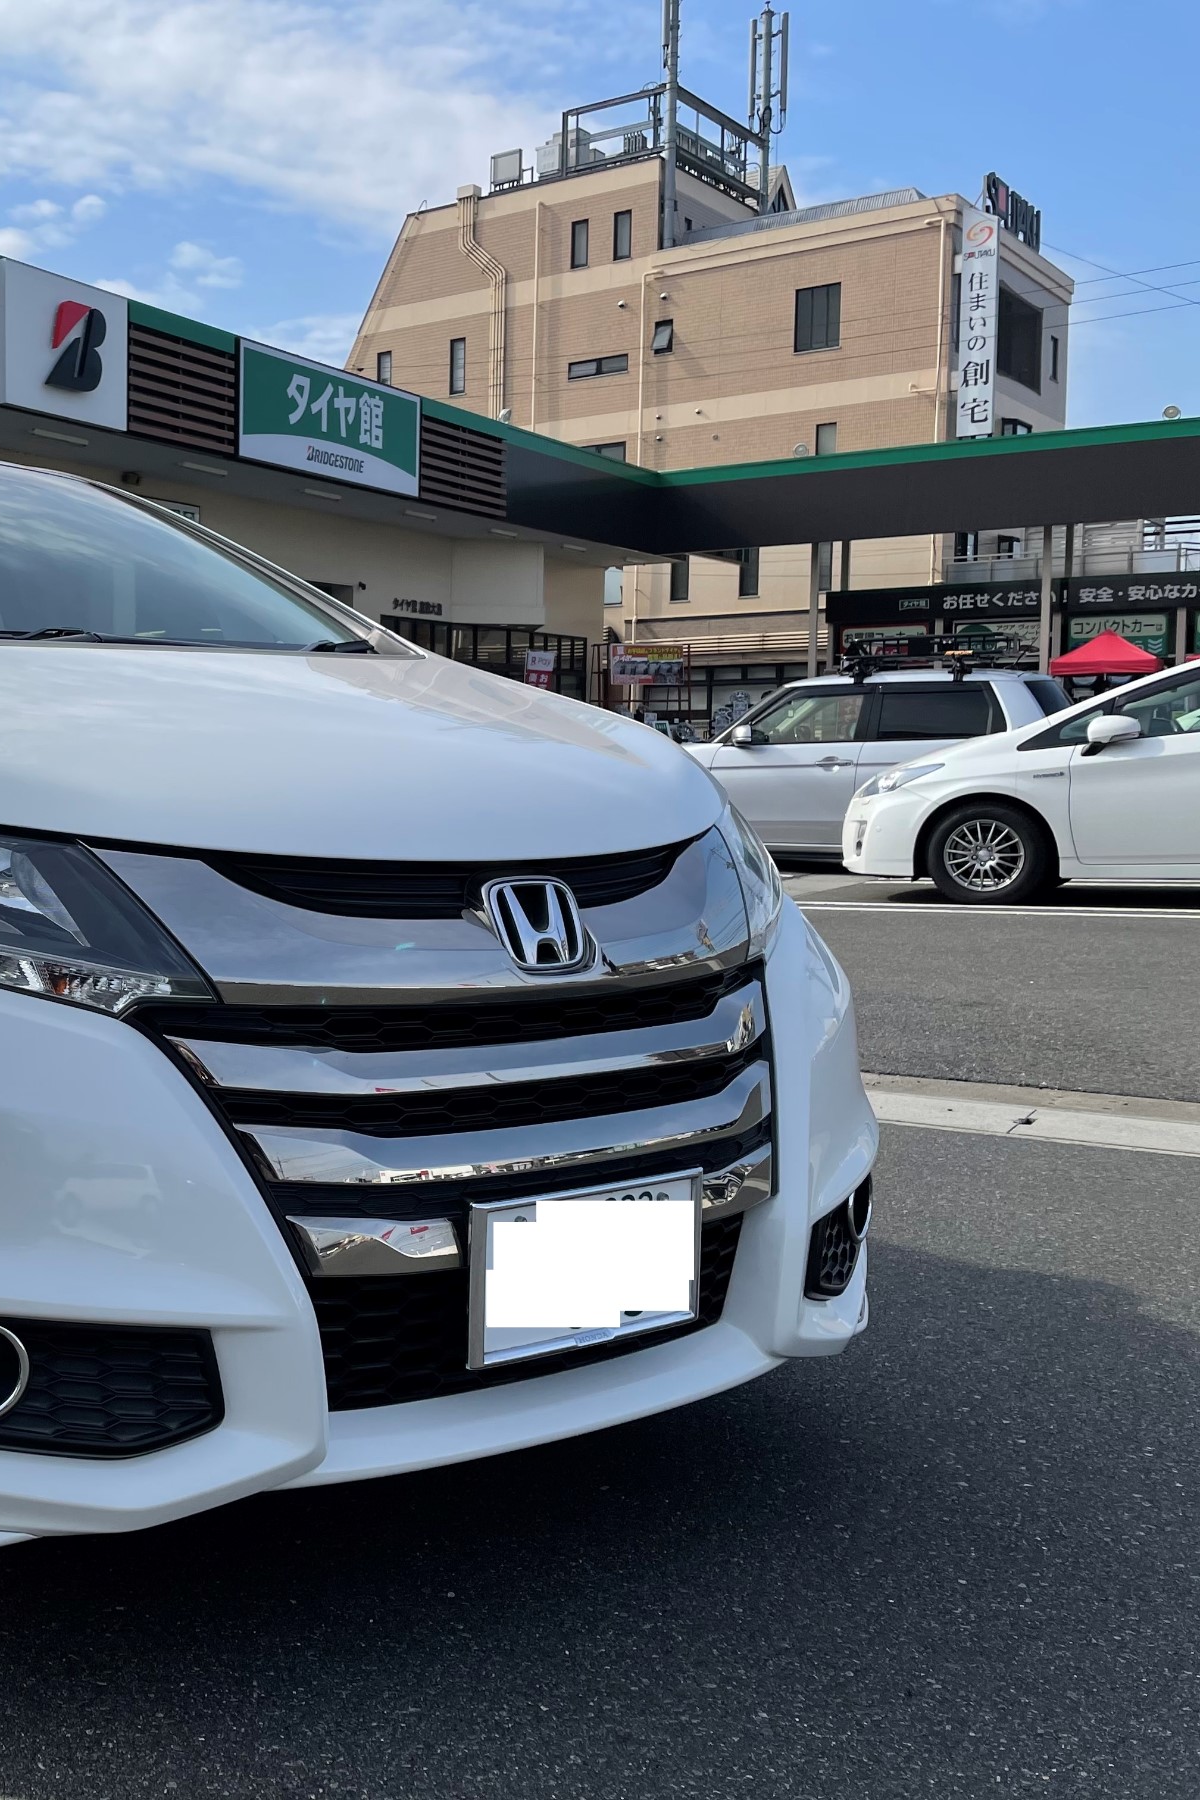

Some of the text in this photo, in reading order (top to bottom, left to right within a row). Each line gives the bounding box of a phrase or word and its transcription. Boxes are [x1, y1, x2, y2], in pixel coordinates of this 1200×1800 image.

[960, 272, 991, 424] 住まいの創宅
[286, 373, 384, 450] タイヤ館
[306, 445, 365, 473] BRIDGESTONE
[1079, 583, 1200, 604] 安全・安心なカ
[578, 1332, 608, 1344] HONDA
